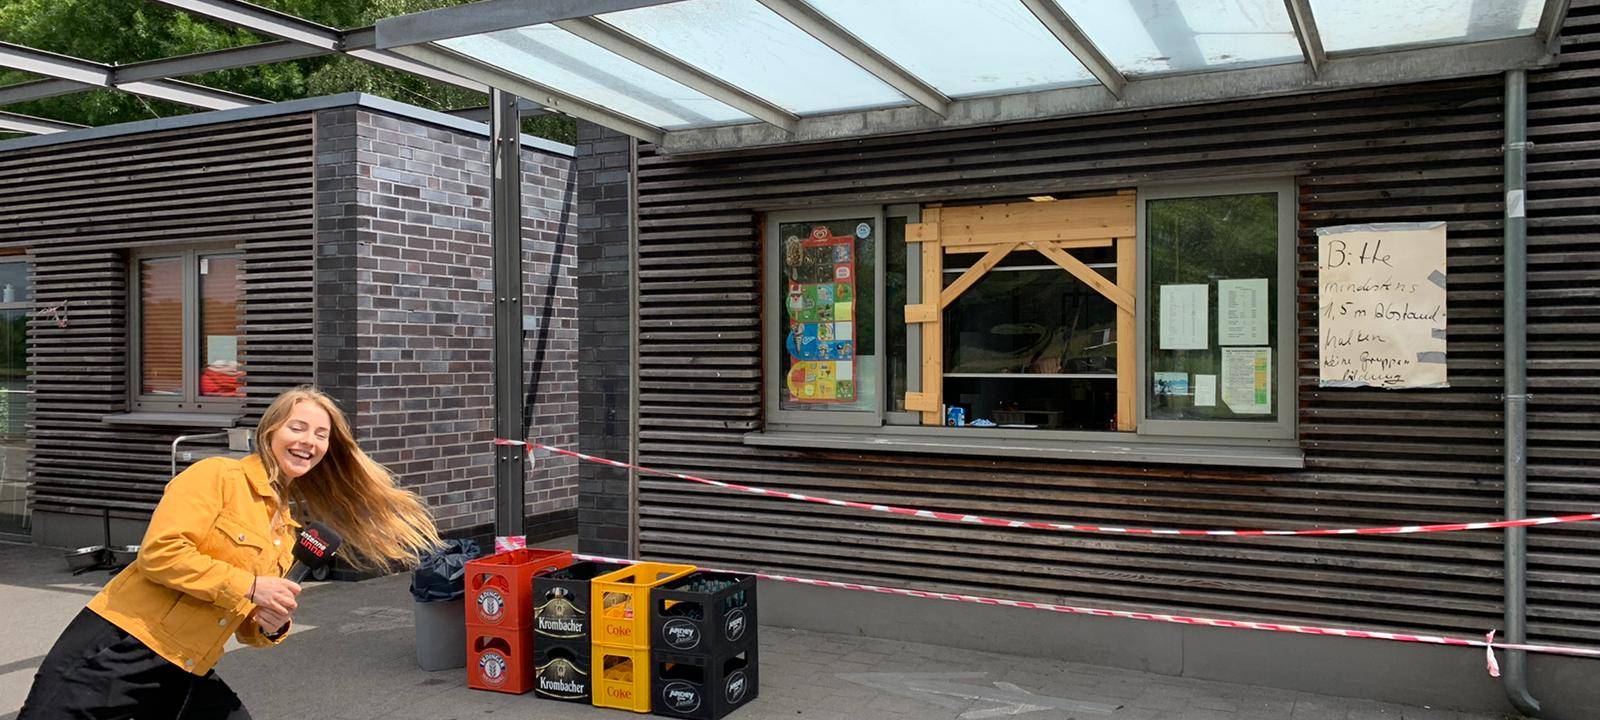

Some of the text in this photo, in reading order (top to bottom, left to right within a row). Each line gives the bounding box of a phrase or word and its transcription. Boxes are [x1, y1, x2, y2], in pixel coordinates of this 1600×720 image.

[1328, 239, 1392, 270] Bitte
[1324, 276, 1419, 294] mindestens
[1354, 309, 1367, 318] m
[1375, 303, 1440, 322] Abstand
[1325, 327, 1386, 350] halten
[1324, 351, 1411, 371] keine Gruppen
[300, 531, 326, 551] antenna
[478, 591, 504, 606] ERDINGER
[539, 616, 583, 632] Krombacher
[606, 624, 631, 636] Coke
[480, 653, 505, 668] ERDINGER
[540, 677, 585, 694] Krombacher
[606, 686, 631, 699] Coke
